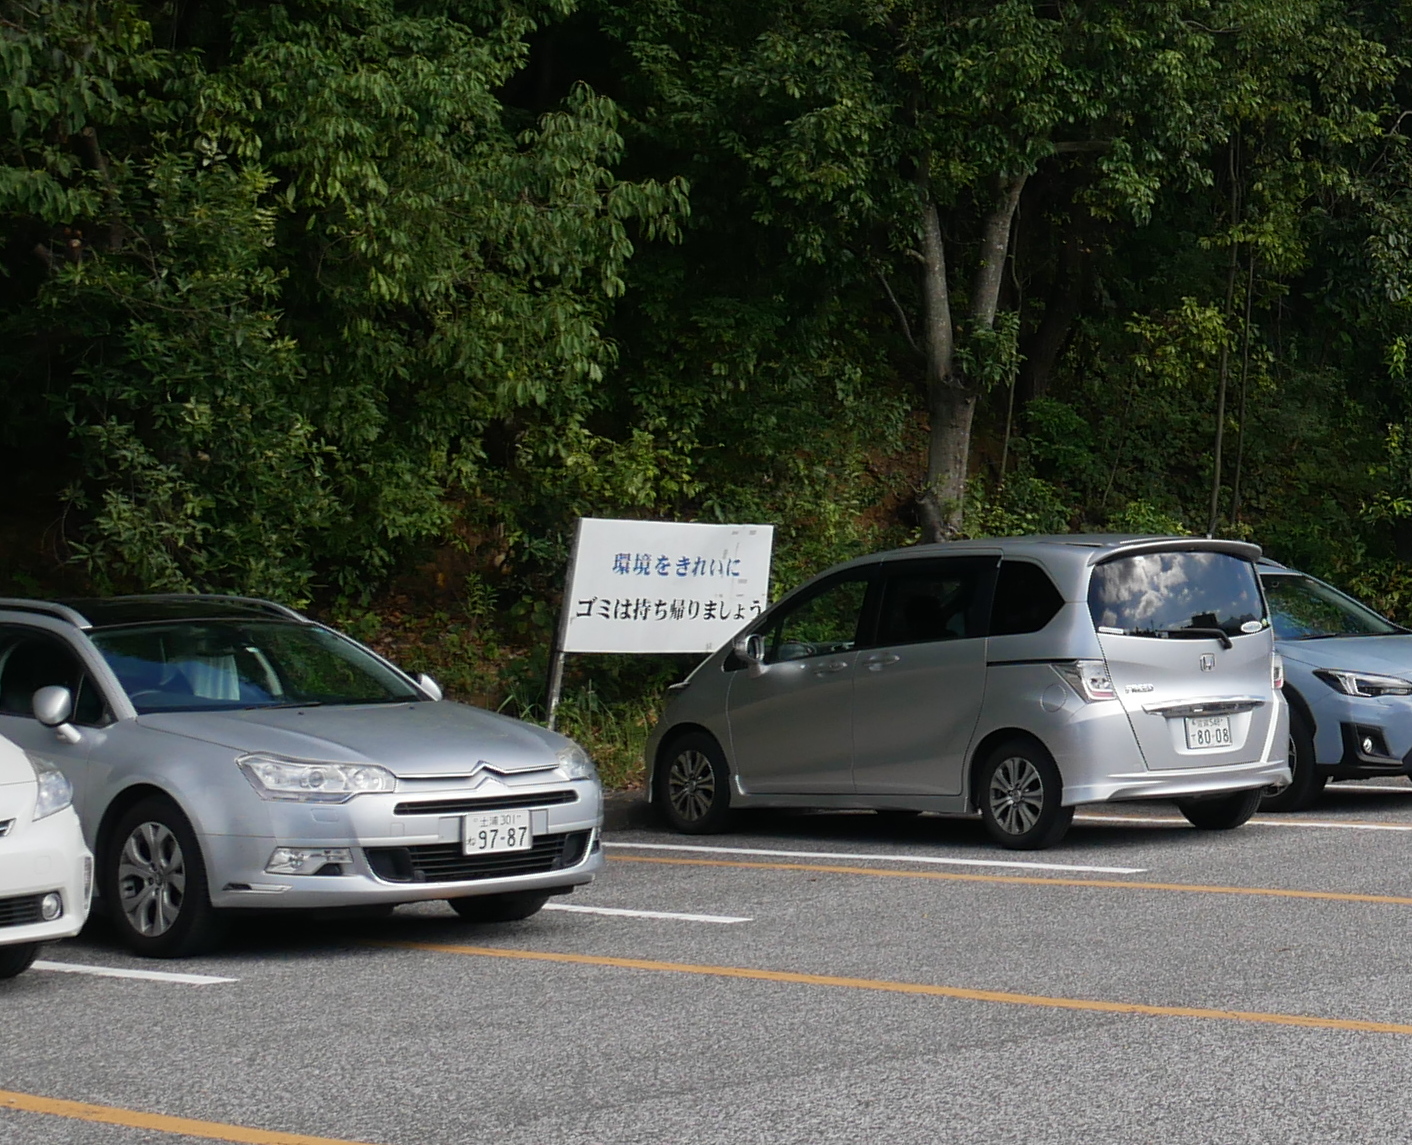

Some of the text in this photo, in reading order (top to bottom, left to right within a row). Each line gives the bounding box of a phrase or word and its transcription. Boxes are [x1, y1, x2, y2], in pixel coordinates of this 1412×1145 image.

[612, 552, 742, 577] 環境をきれいに
[576, 596, 762, 621] ゴミは持ち帰りましょう
[478, 826, 528, 849] 97-87
